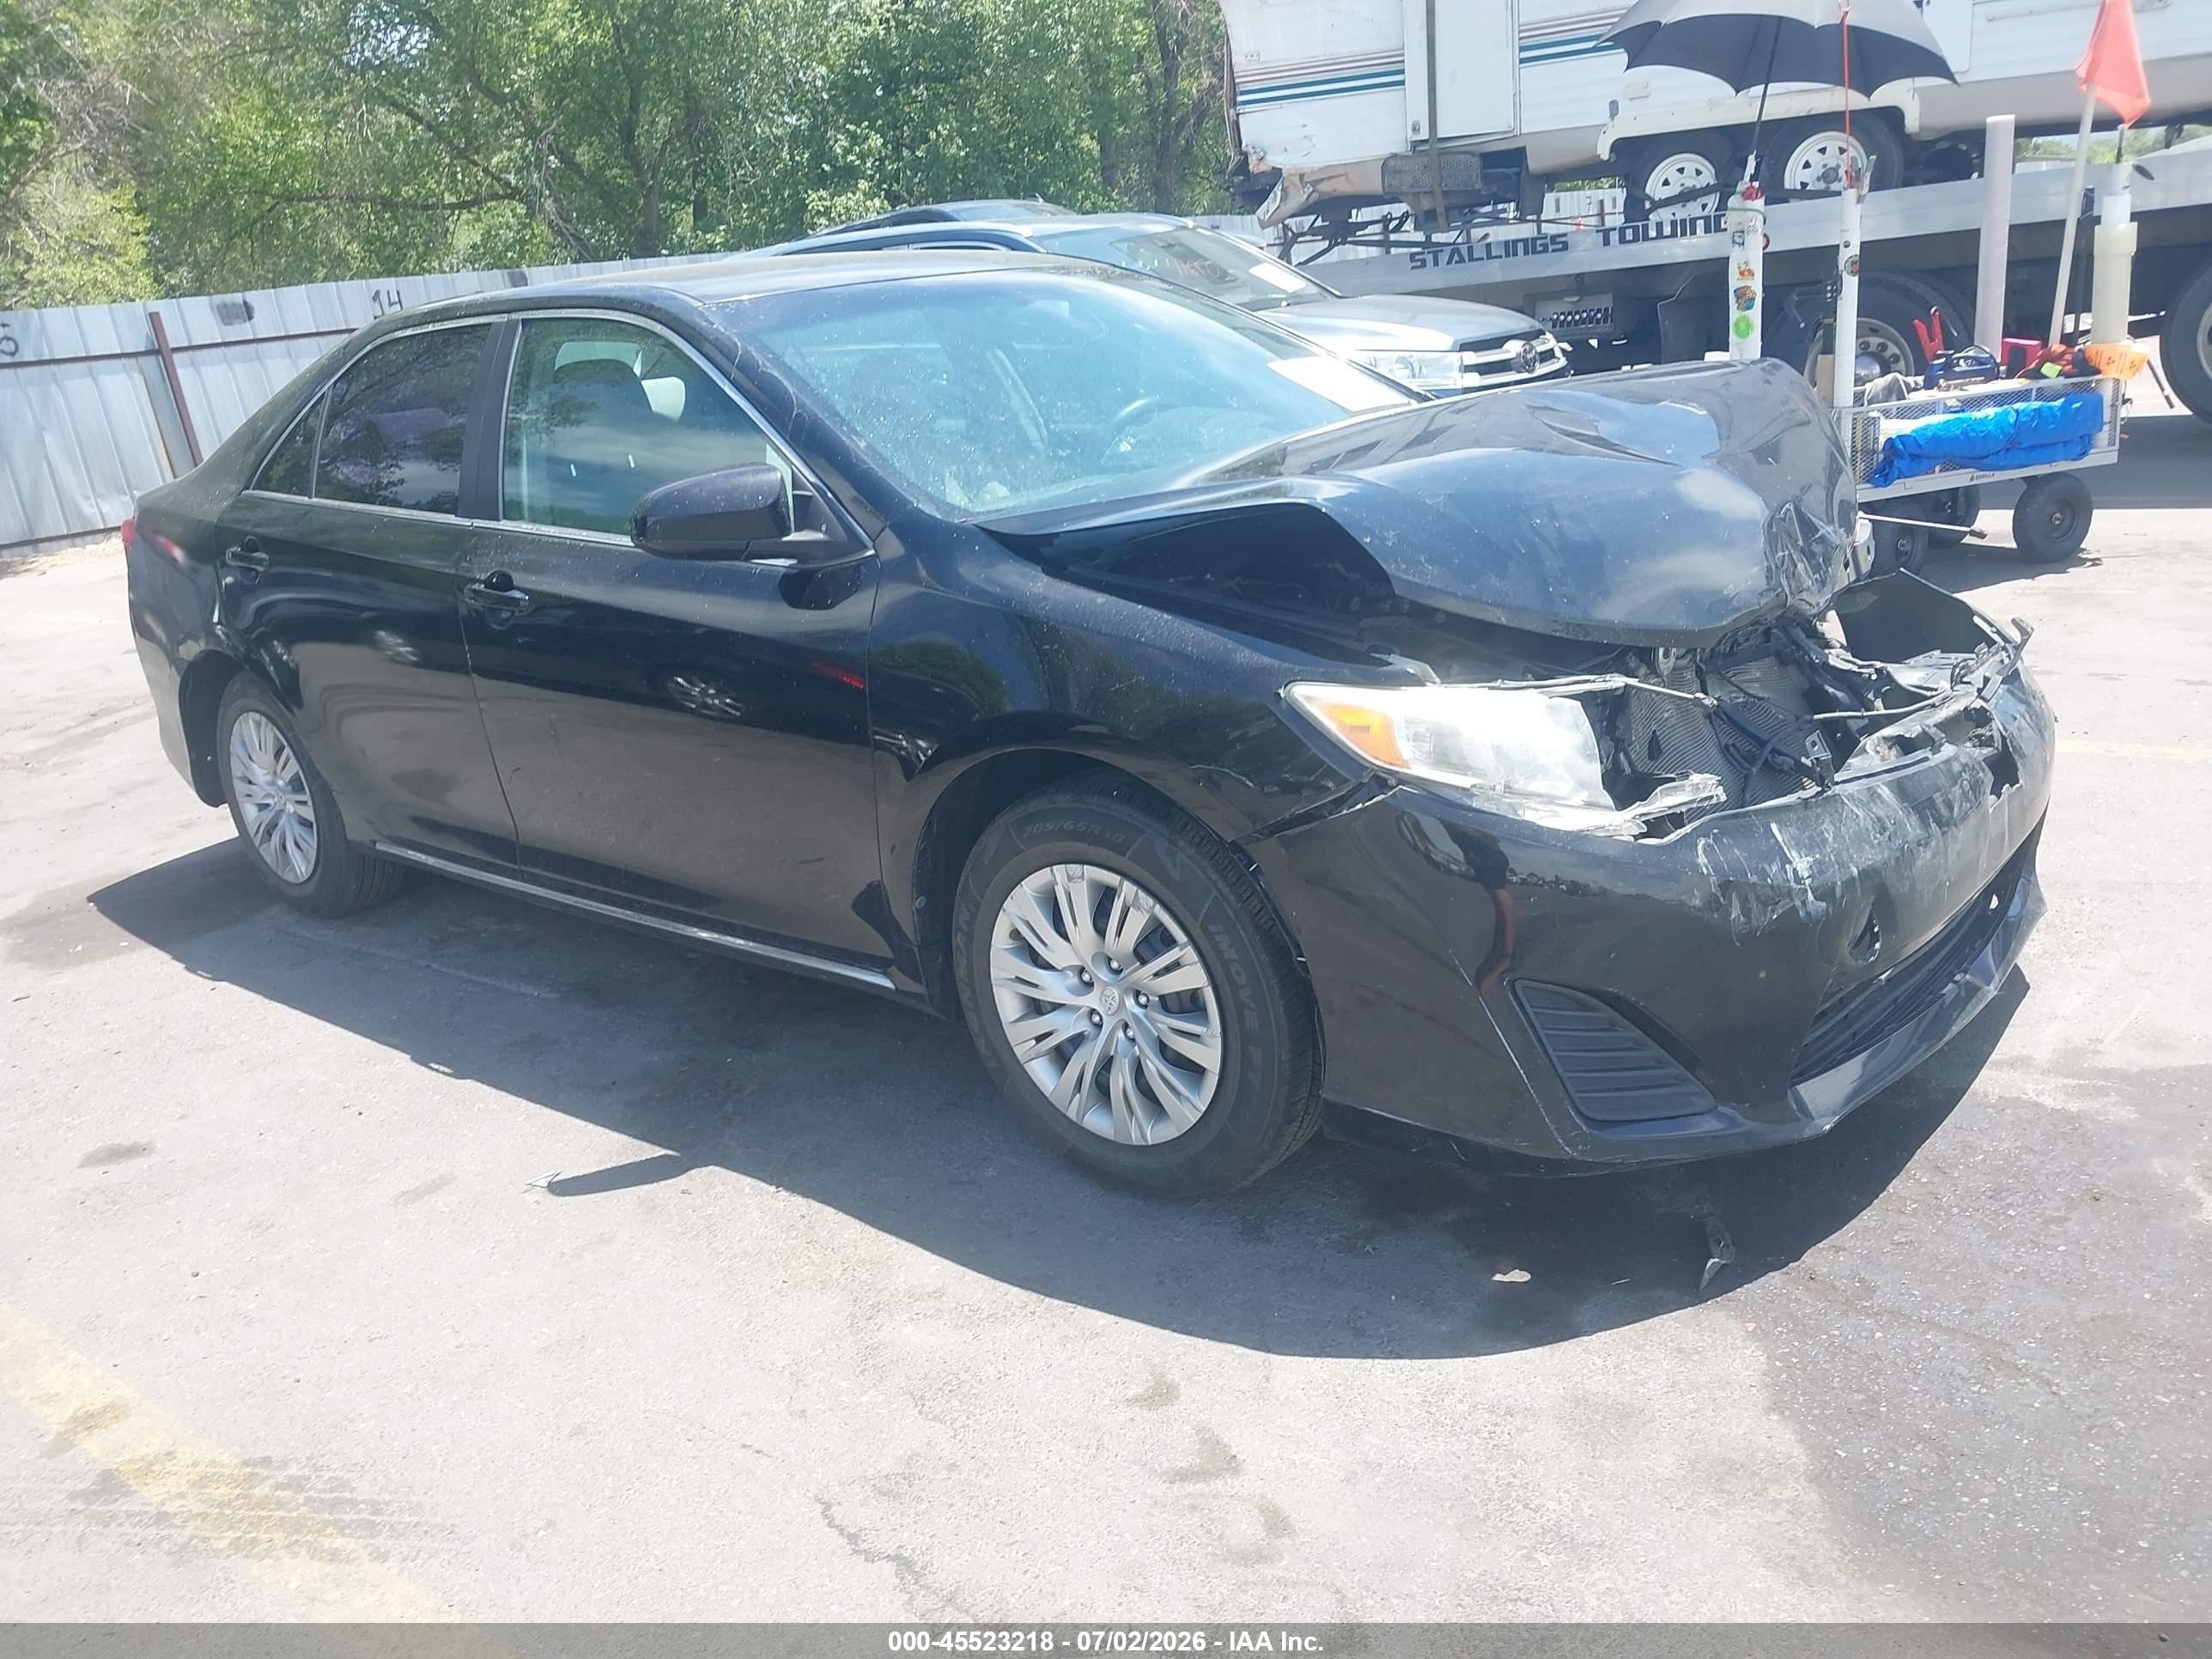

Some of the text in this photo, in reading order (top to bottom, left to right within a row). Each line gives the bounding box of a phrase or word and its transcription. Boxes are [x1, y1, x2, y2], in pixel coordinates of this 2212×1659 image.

[1410, 233, 1569, 270] STALLINGS
[1595, 213, 1729, 247] TOWING
[372, 289, 404, 320] 14
